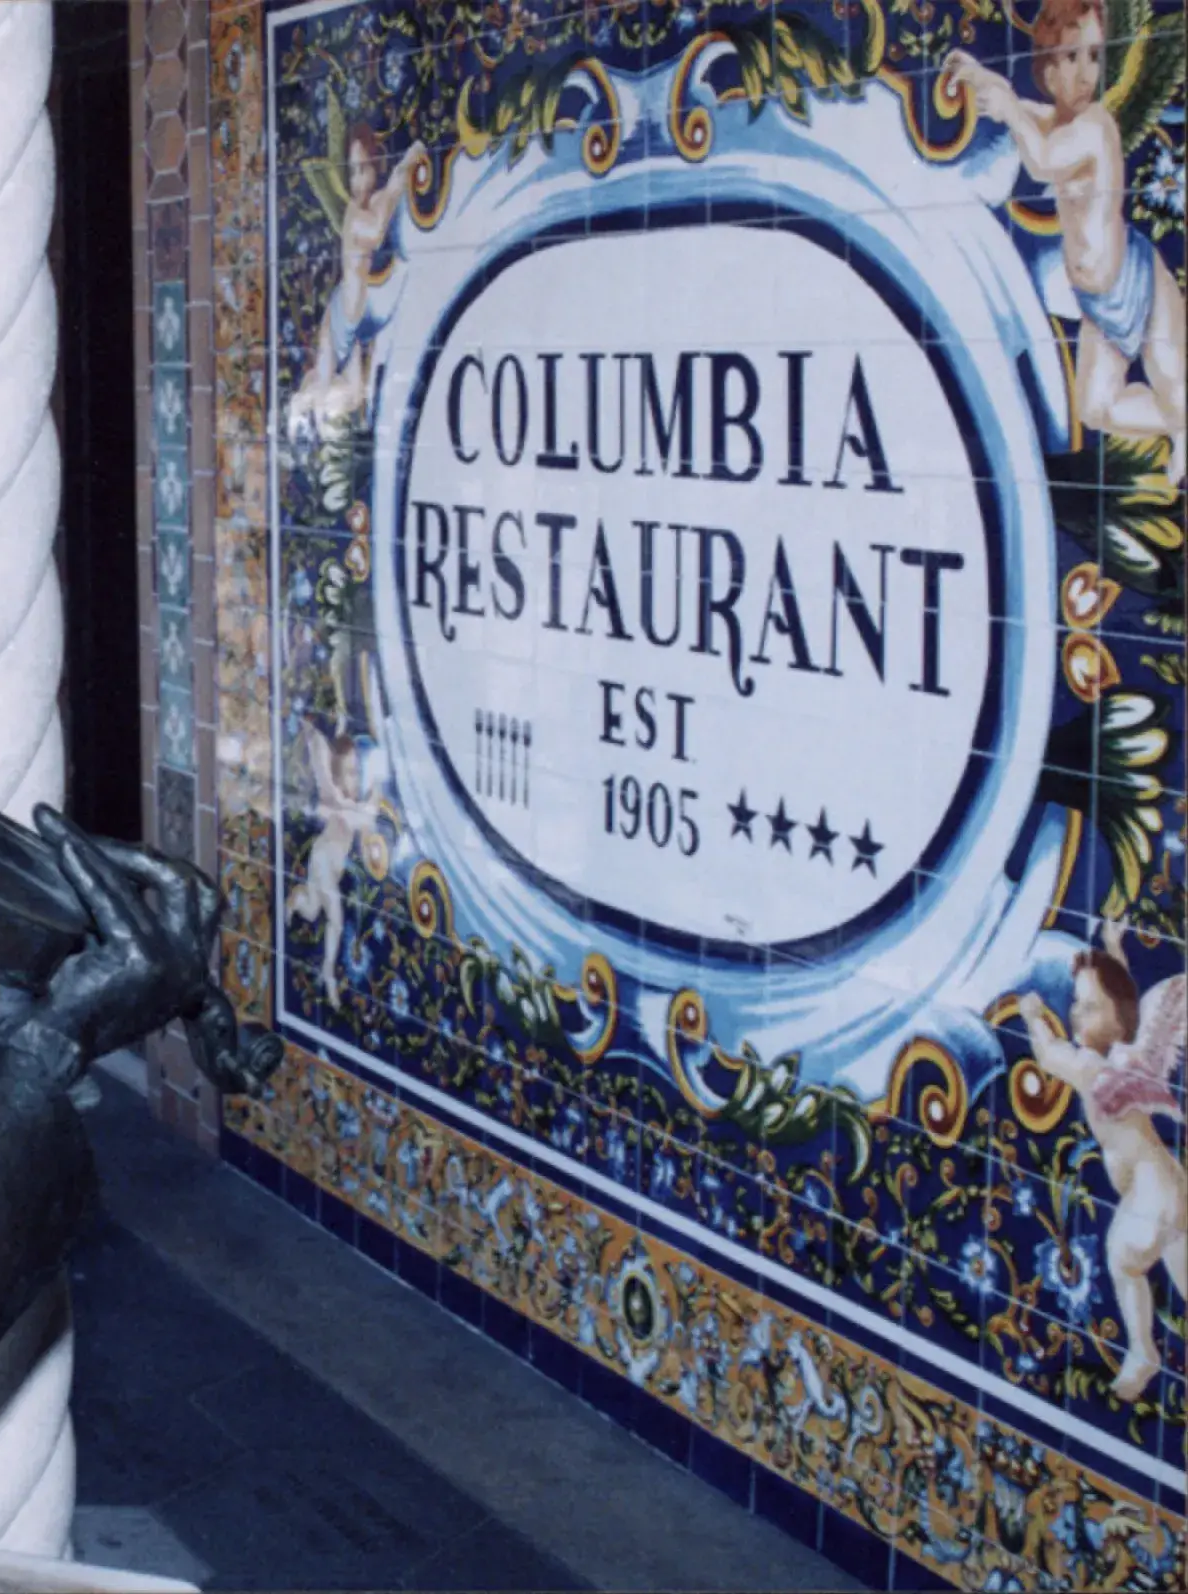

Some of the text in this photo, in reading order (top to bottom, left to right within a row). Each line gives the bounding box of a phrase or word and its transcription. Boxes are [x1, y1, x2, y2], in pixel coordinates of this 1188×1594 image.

[446, 349, 904, 494] COLUMBIA
[411, 500, 966, 698] RESTAURANT
[597, 679, 696, 763] EST
[602, 773, 701, 858] 1905
